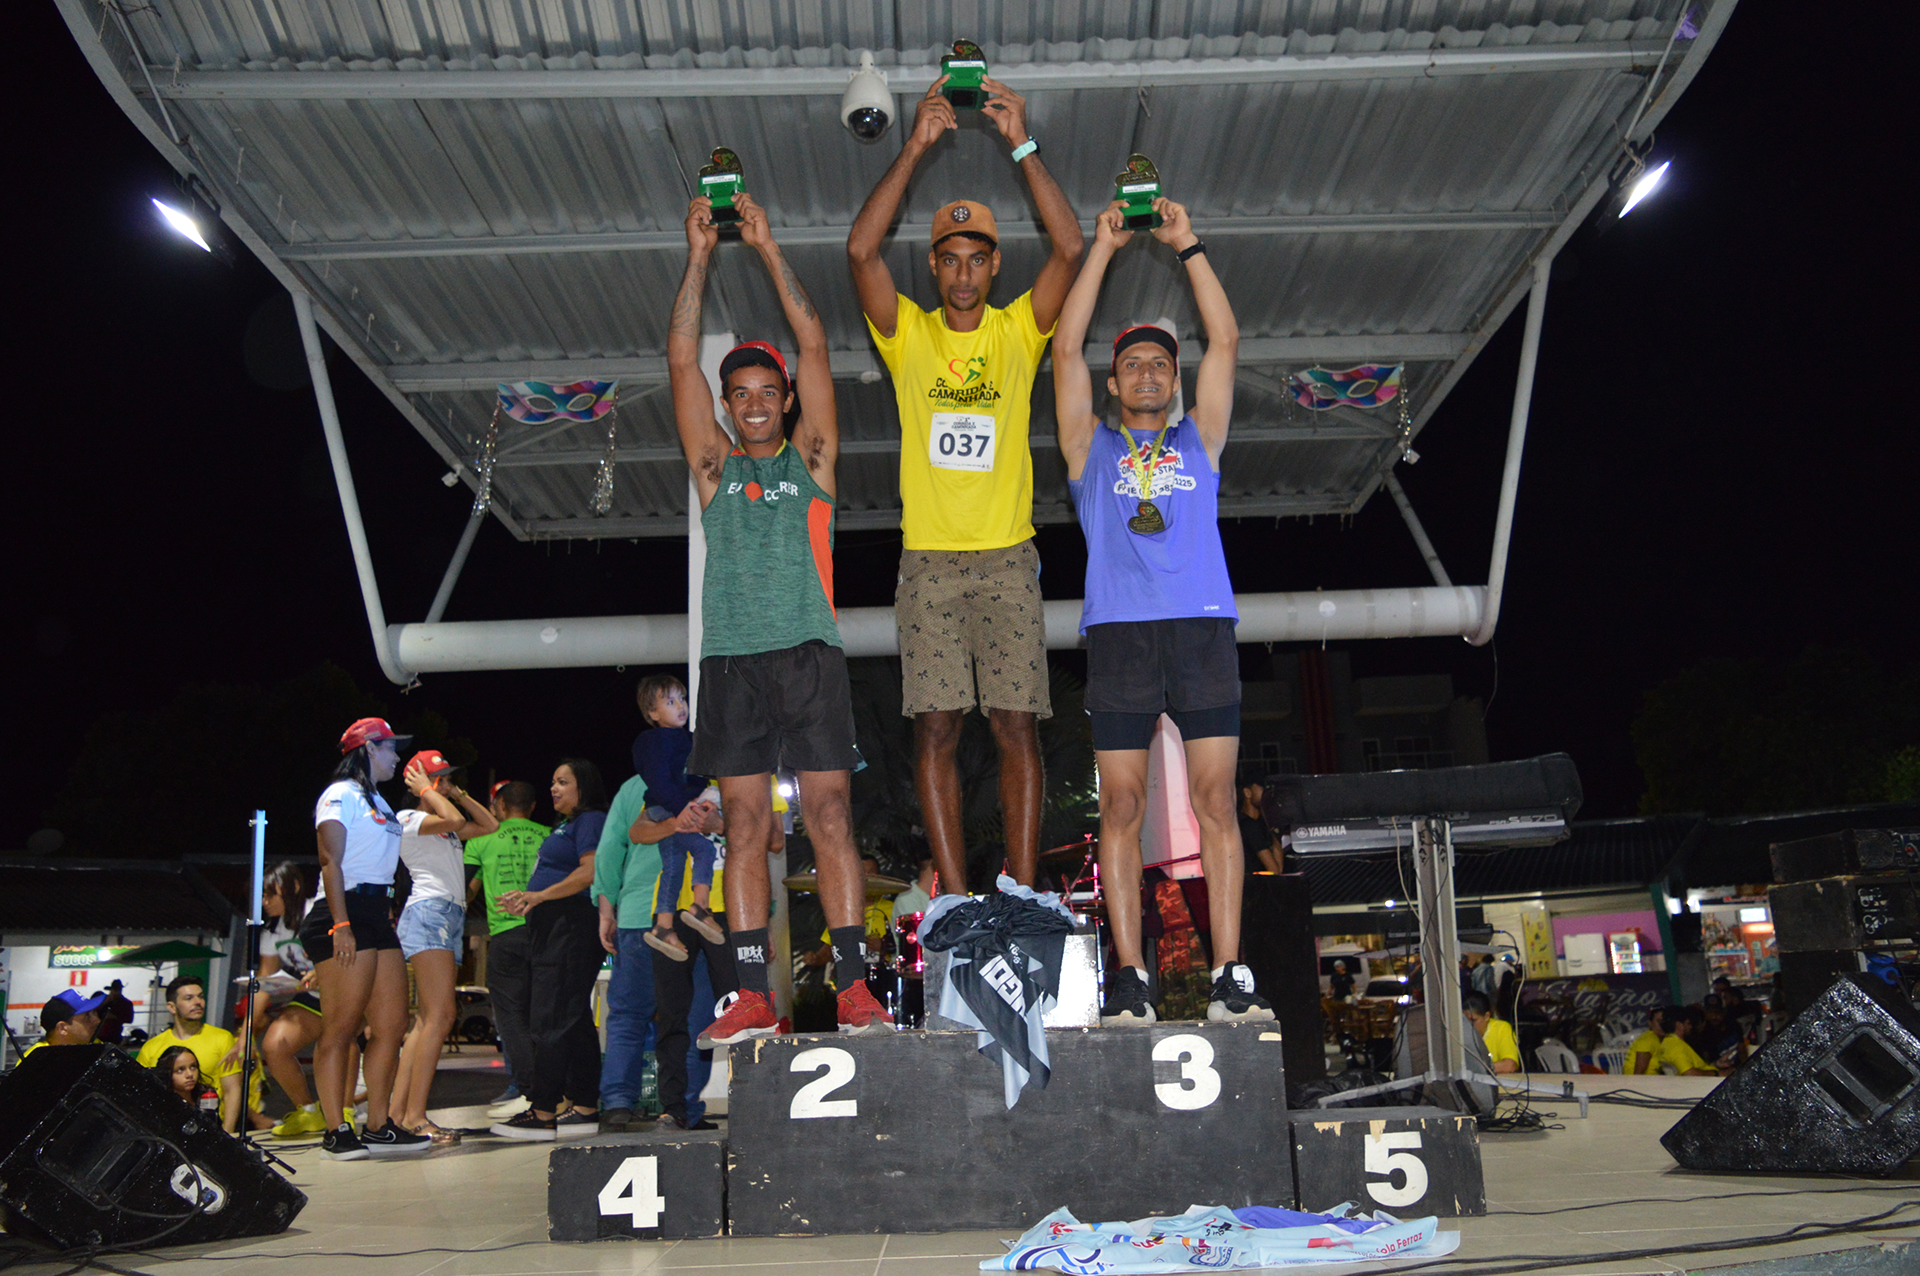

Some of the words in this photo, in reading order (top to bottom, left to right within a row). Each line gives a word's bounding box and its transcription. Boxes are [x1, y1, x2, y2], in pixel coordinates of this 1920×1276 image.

[928, 388, 1001, 403] CAMINHADA
[939, 432, 991, 458] 037
[1308, 825, 1347, 838] YAMAHA
[789, 1047, 858, 1120] 2
[1151, 1034, 1222, 1111] 3
[597, 1155, 666, 1229] 4
[1364, 1131, 1429, 1207] 5
[1396, 1231, 1423, 1250] Ferraz
